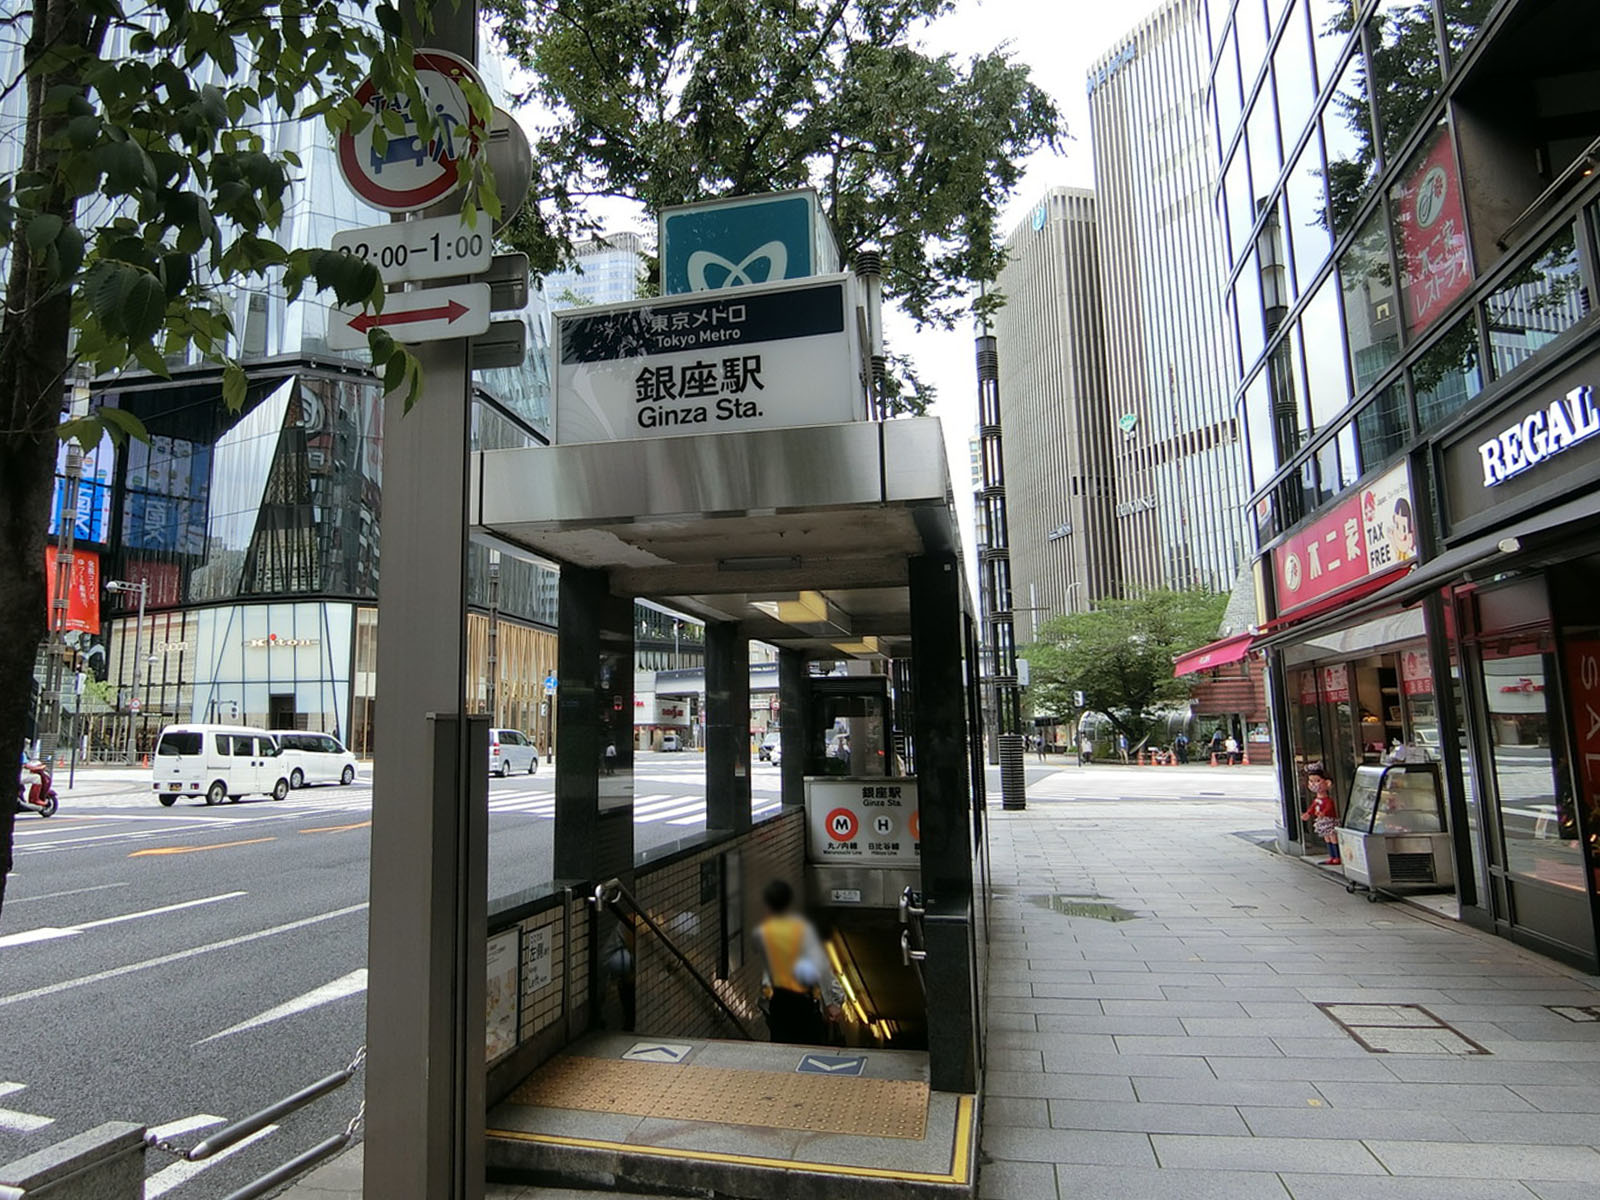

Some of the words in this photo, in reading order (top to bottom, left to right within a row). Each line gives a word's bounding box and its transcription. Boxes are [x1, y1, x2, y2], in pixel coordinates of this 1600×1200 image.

[650, 304, 746, 334] 東京メトロ
[656, 335, 696, 348] Tokyo
[699, 328, 741, 343] Metro
[635, 355, 765, 403] 銀座駅
[637, 406, 707, 428] Ginza
[716, 398, 763, 420] Sta.
[1479, 385, 1600, 487] REGAL
[1367, 522, 1385, 545] TAX
[1370, 544, 1391, 568] FREE
[250, 634, 311, 648] Kiton
[862, 786, 902, 799] 銀座駅
[862, 799, 885, 807] Ginza
[835, 818, 849, 831] M
[878, 819, 889, 831] H
[827, 842, 858, 850] 丸ノ内線
[868, 842, 900, 850] 日比谷線
